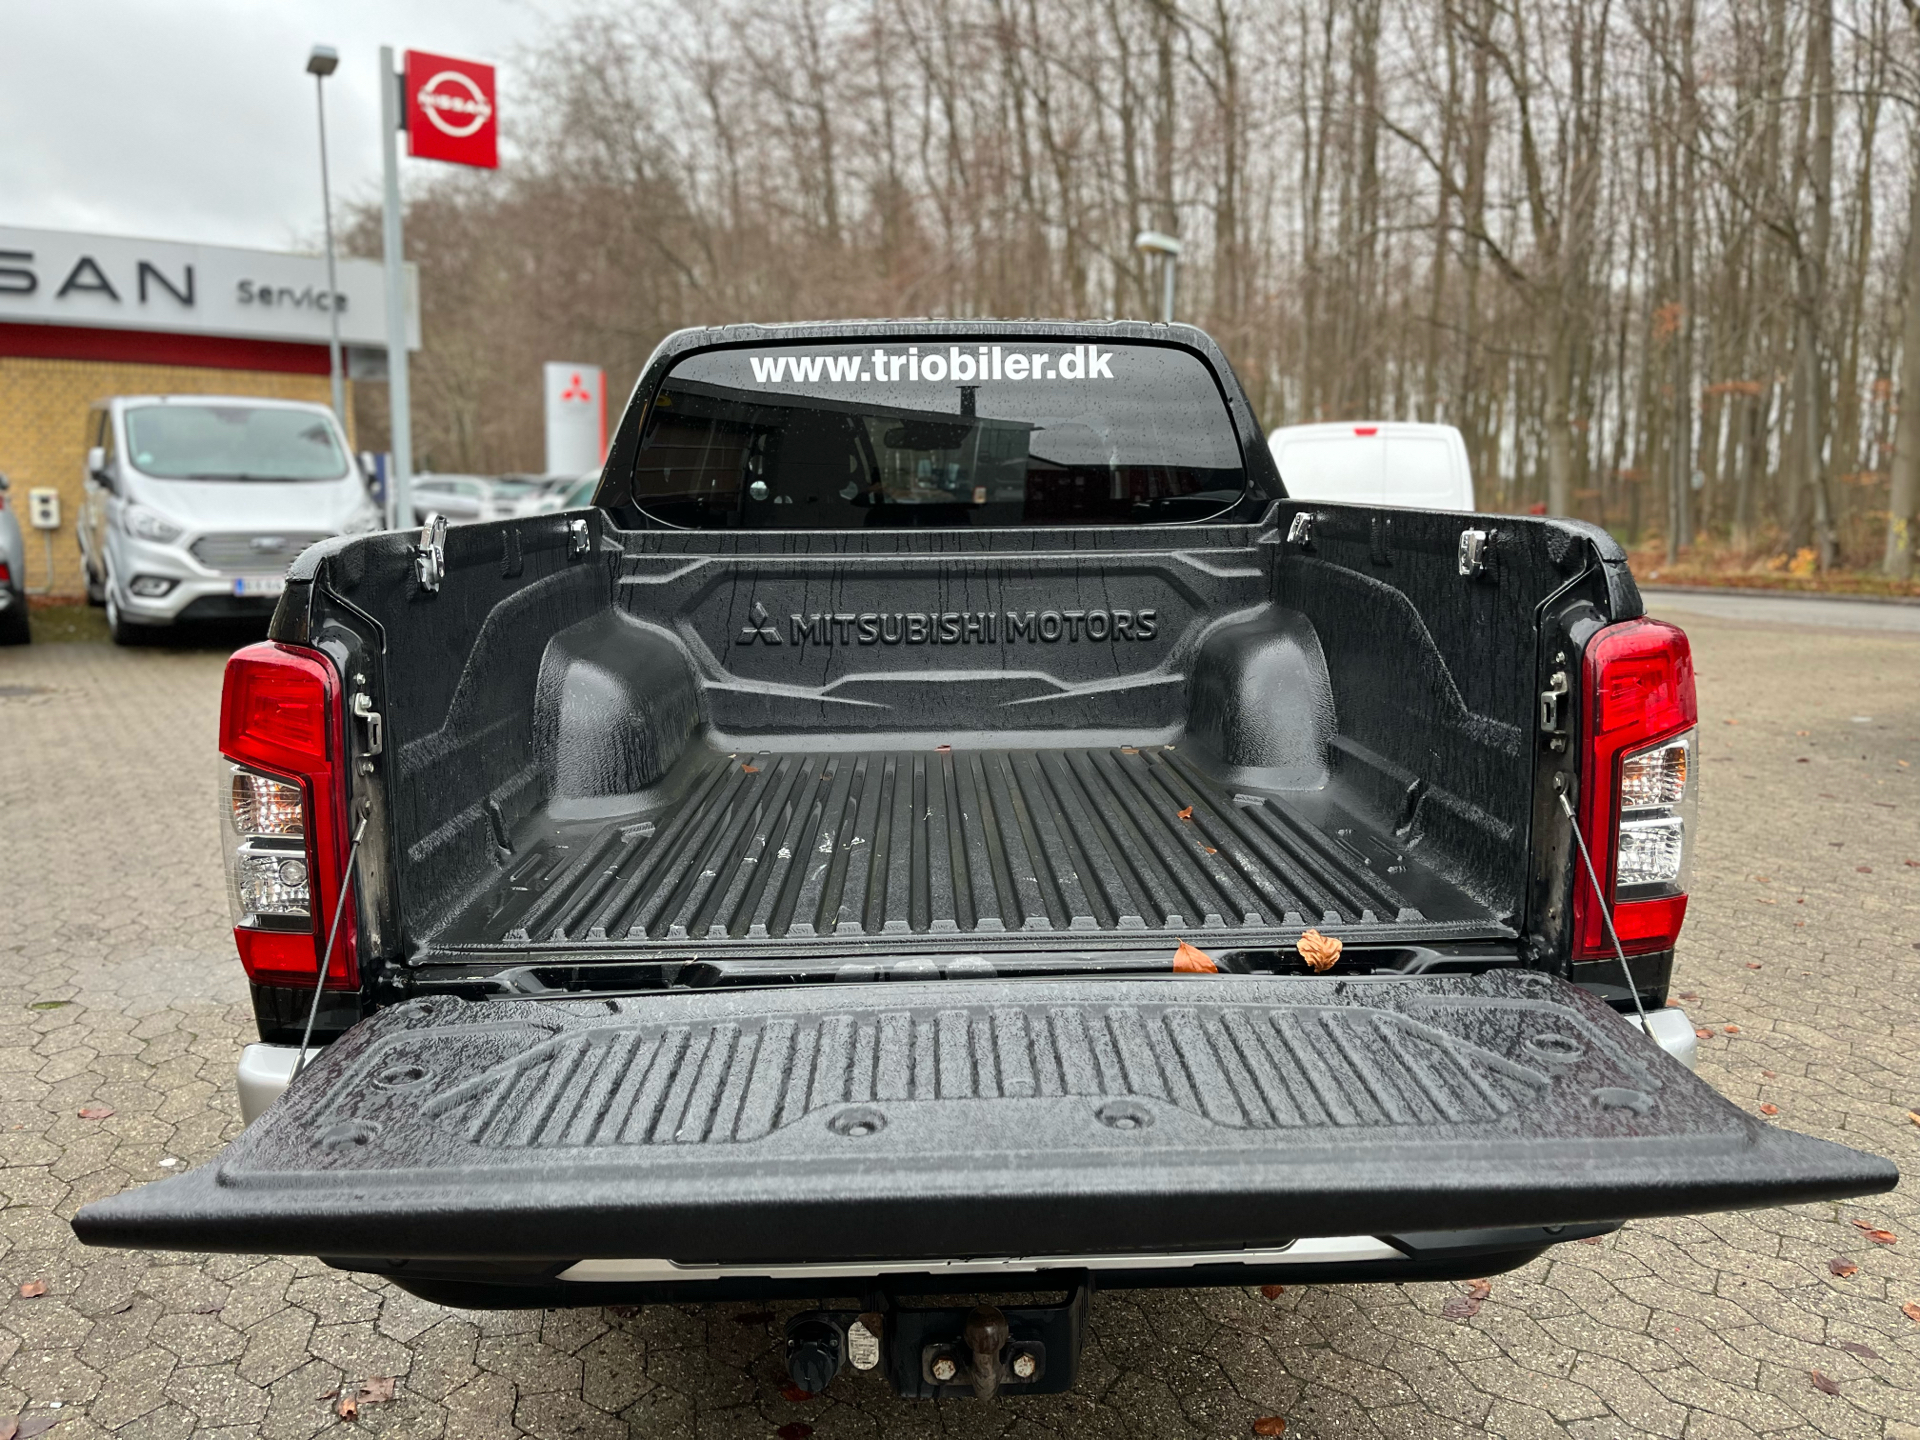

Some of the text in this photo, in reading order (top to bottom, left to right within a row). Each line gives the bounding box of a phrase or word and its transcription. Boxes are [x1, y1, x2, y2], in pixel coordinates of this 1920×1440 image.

[237, 278, 349, 313] Service
[750, 345, 1114, 383] www.triobiler.dk
[790, 609, 1159, 646] MITSUBISHI MOTORS
